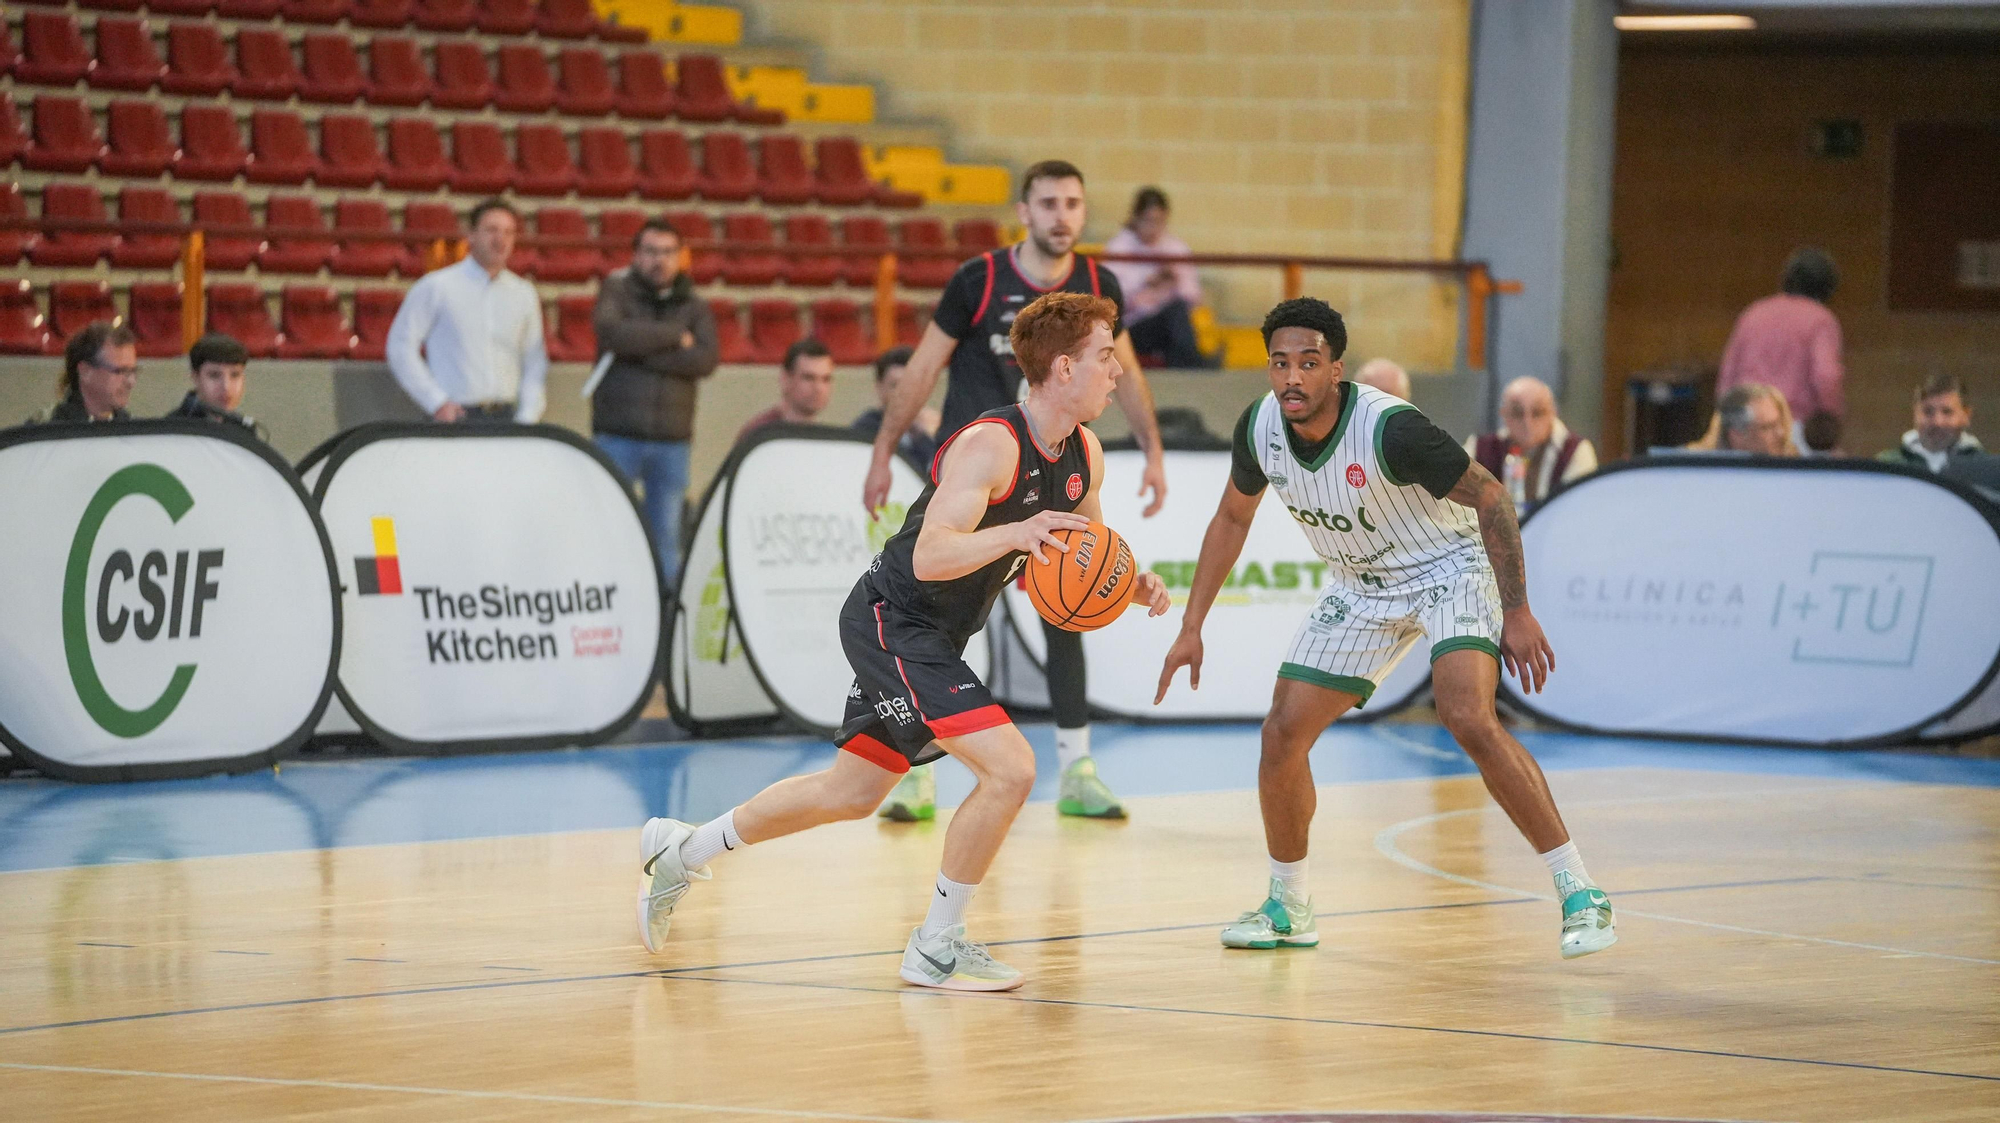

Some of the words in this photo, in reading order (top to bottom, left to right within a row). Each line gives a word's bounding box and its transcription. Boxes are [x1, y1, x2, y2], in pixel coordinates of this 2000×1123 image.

[1097, 537, 1131, 600] Wilson
[1348, 541, 1395, 565] Cajasol
[97, 548, 224, 644] CSIF
[426, 627, 558, 663] Kitchen
